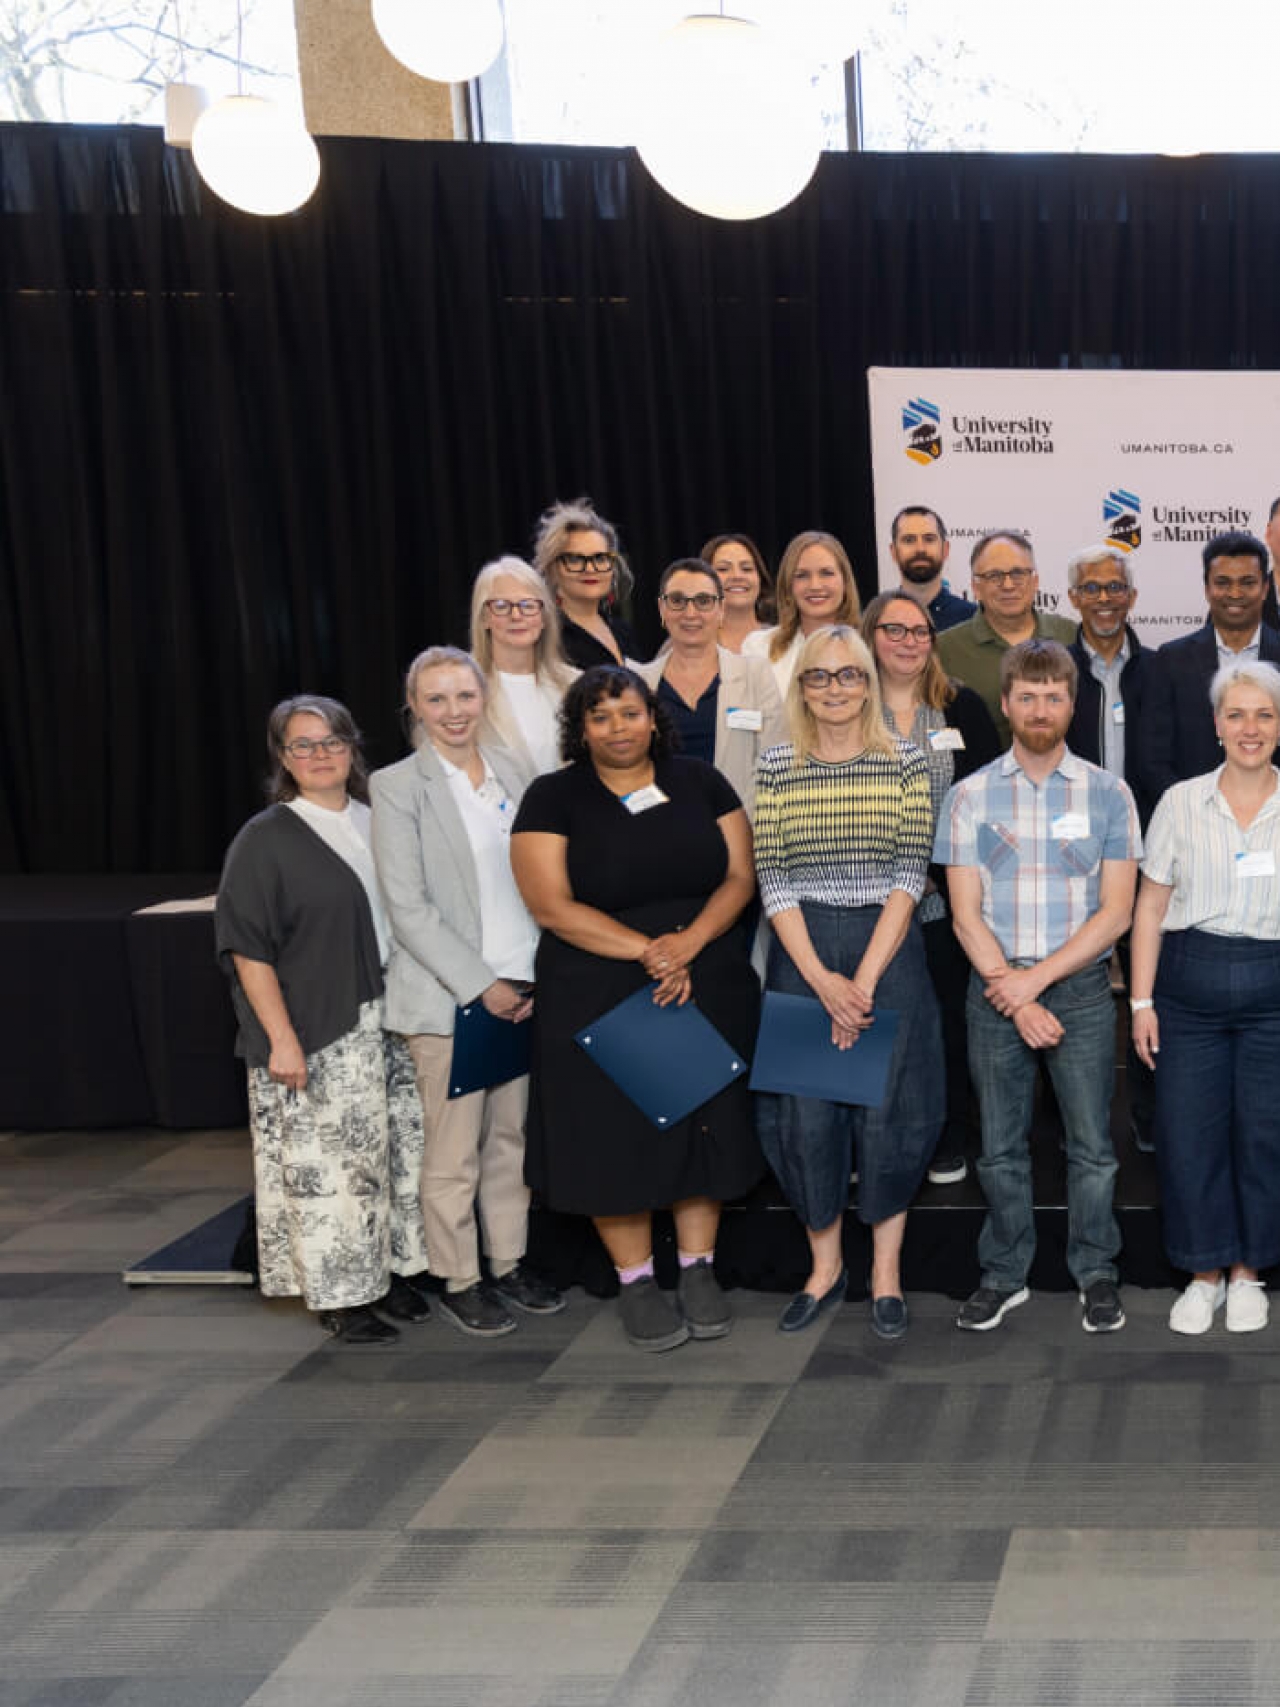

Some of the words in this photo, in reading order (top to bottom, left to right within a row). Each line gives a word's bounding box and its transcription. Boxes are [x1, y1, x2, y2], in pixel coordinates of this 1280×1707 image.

[952, 416, 1053, 438] University
[964, 436, 1054, 453] Manitoba
[1120, 443, 1234, 454] UMANITOBA.CA
[1153, 506, 1252, 526] University
